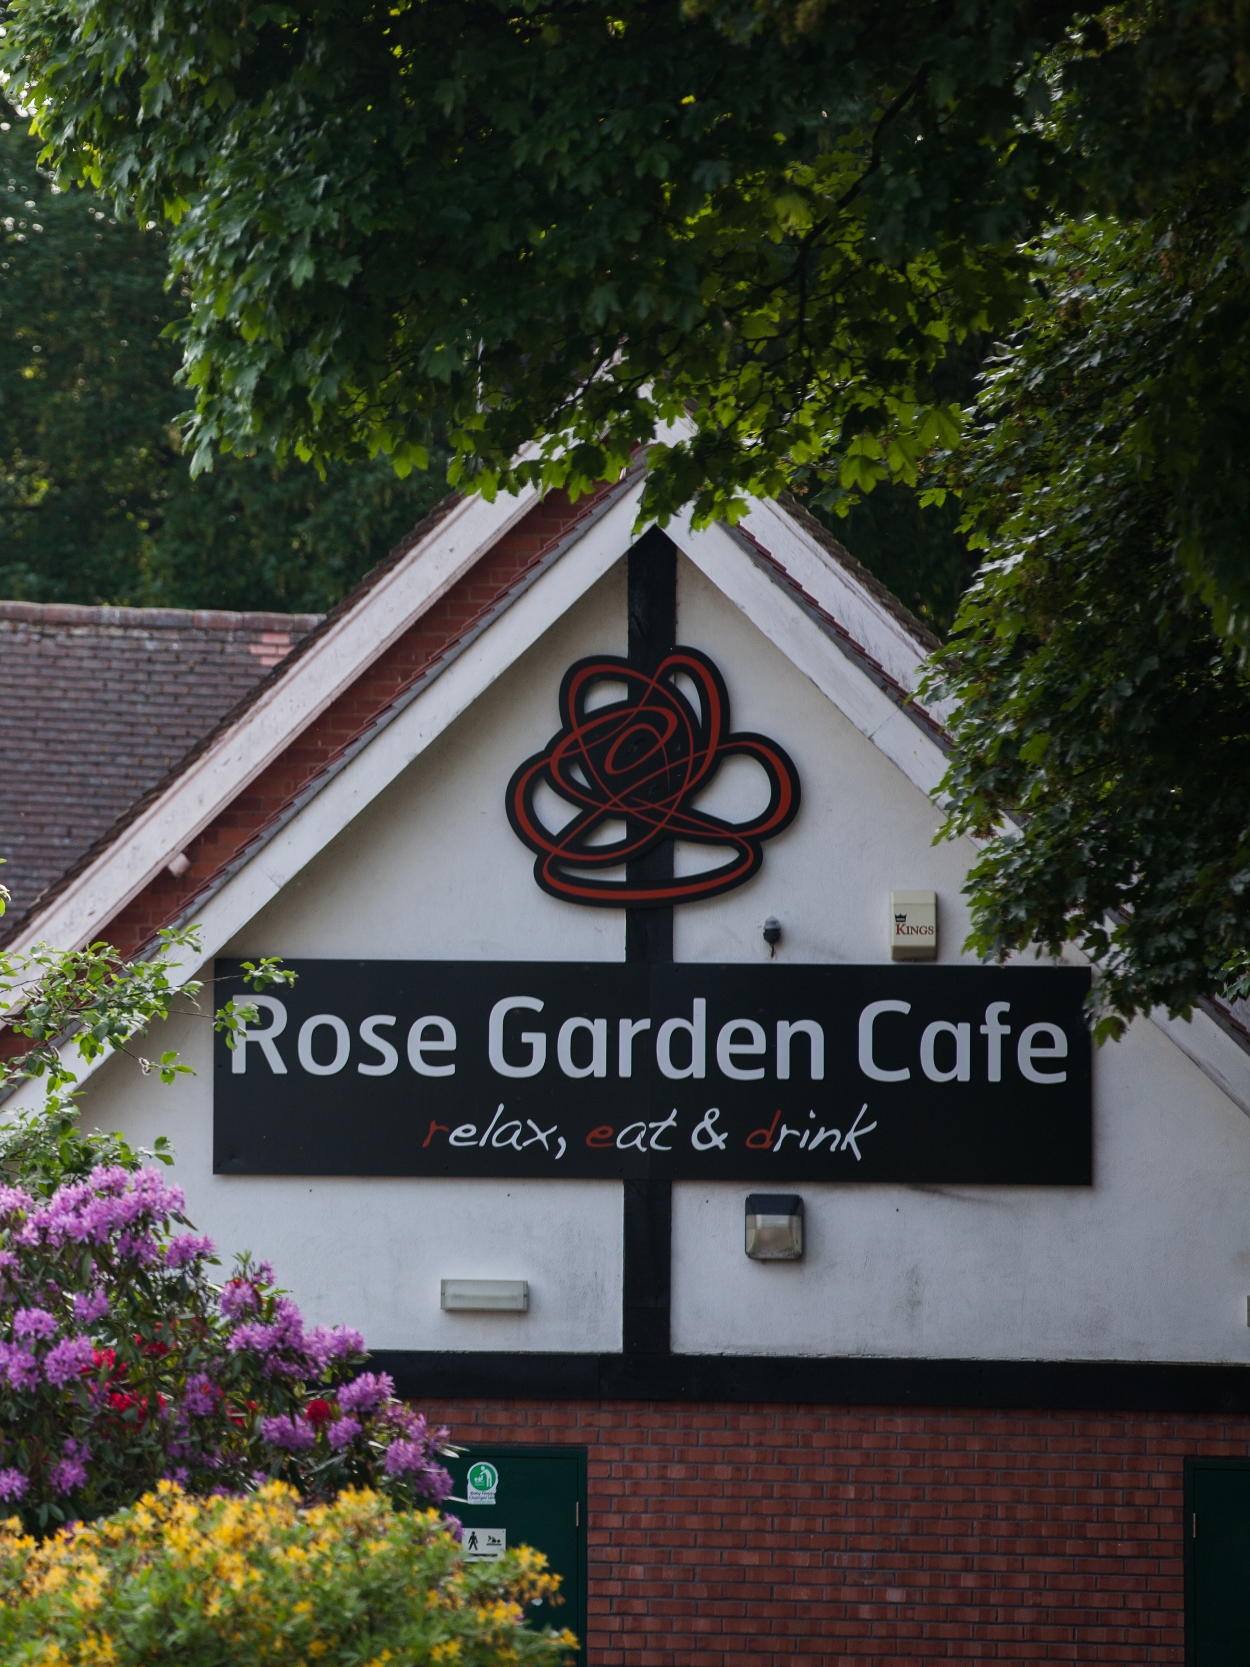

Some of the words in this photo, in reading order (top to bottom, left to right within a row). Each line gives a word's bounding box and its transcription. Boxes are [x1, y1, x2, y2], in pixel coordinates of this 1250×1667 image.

[231, 994, 457, 1078] Rose
[488, 995, 825, 1081] Garden
[858, 999, 1068, 1084] Cafe
[422, 1103, 567, 1160] relax,
[585, 1108, 678, 1153] eat
[691, 1107, 729, 1152] &
[745, 1103, 878, 1162] drink
